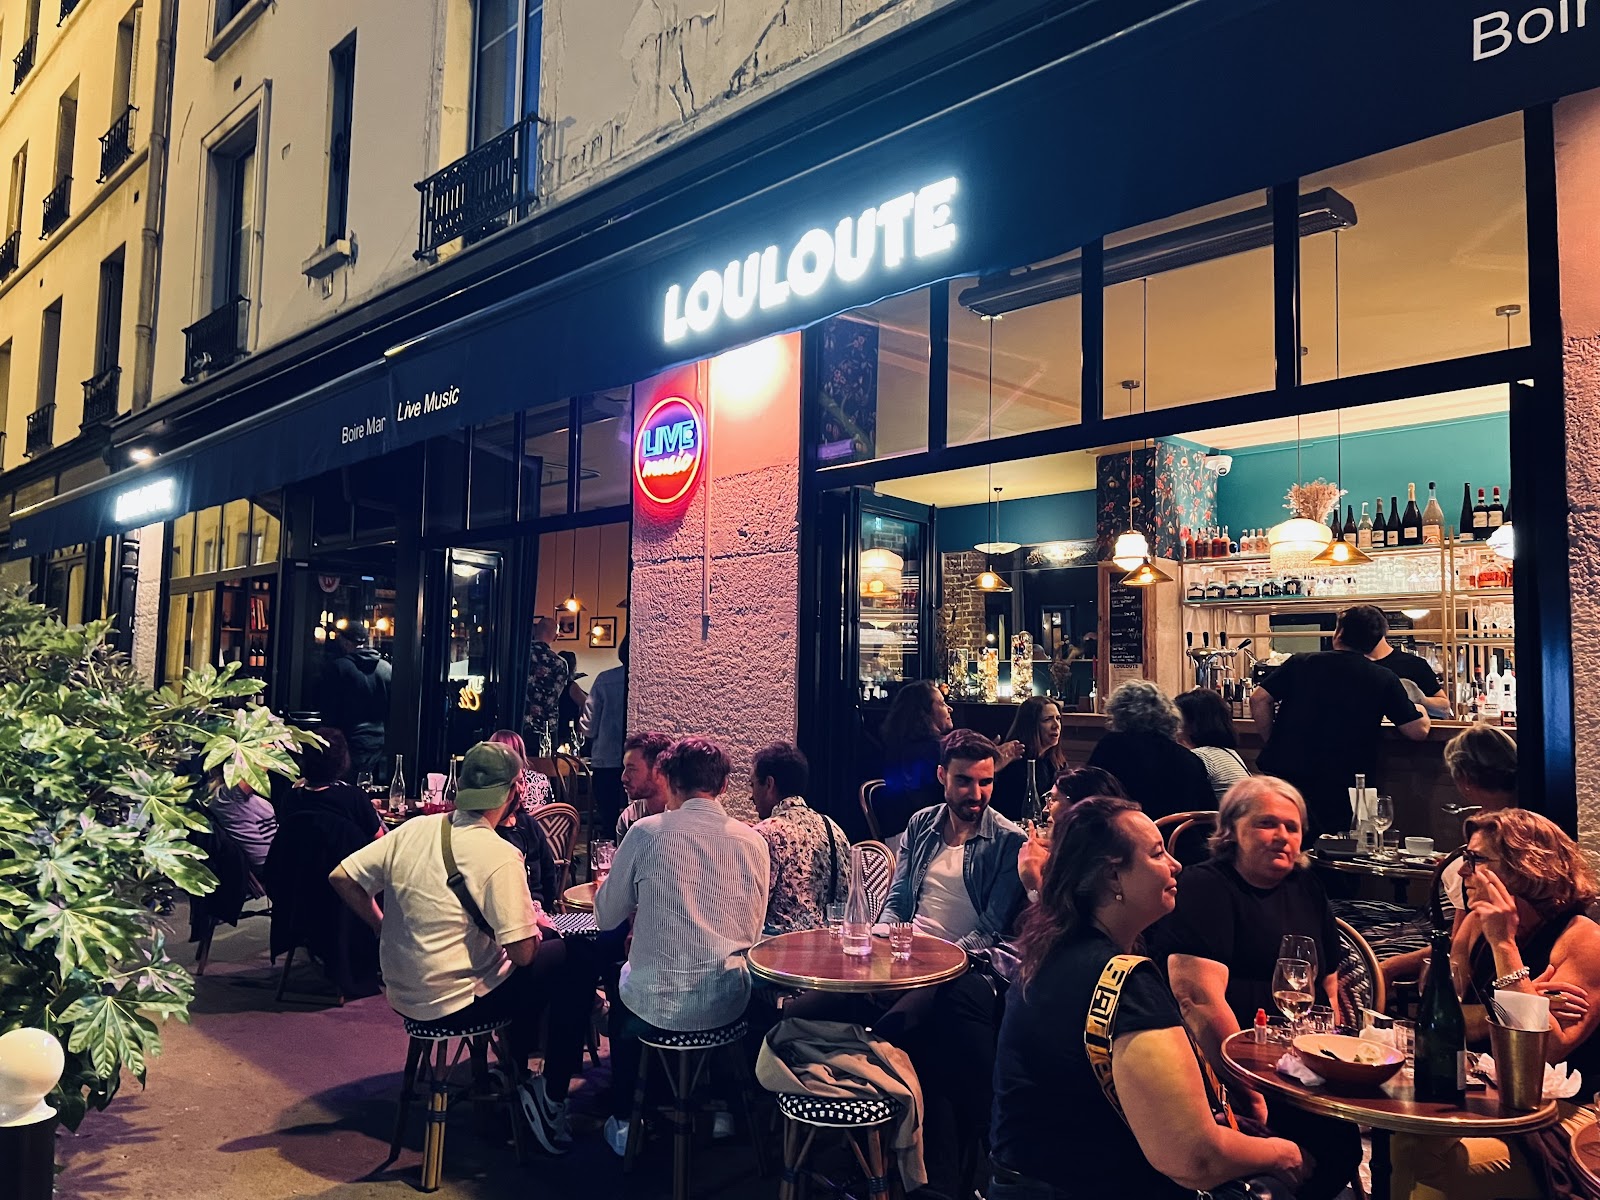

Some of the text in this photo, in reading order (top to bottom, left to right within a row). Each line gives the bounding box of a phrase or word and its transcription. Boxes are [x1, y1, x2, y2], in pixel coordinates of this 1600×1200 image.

[1473, 0, 1589, 61] Boir
[663, 176, 957, 343] LOULOUTE
[397, 385, 460, 421] Live Music
[341, 424, 364, 444] Boire
[642, 419, 695, 458] LIVE
